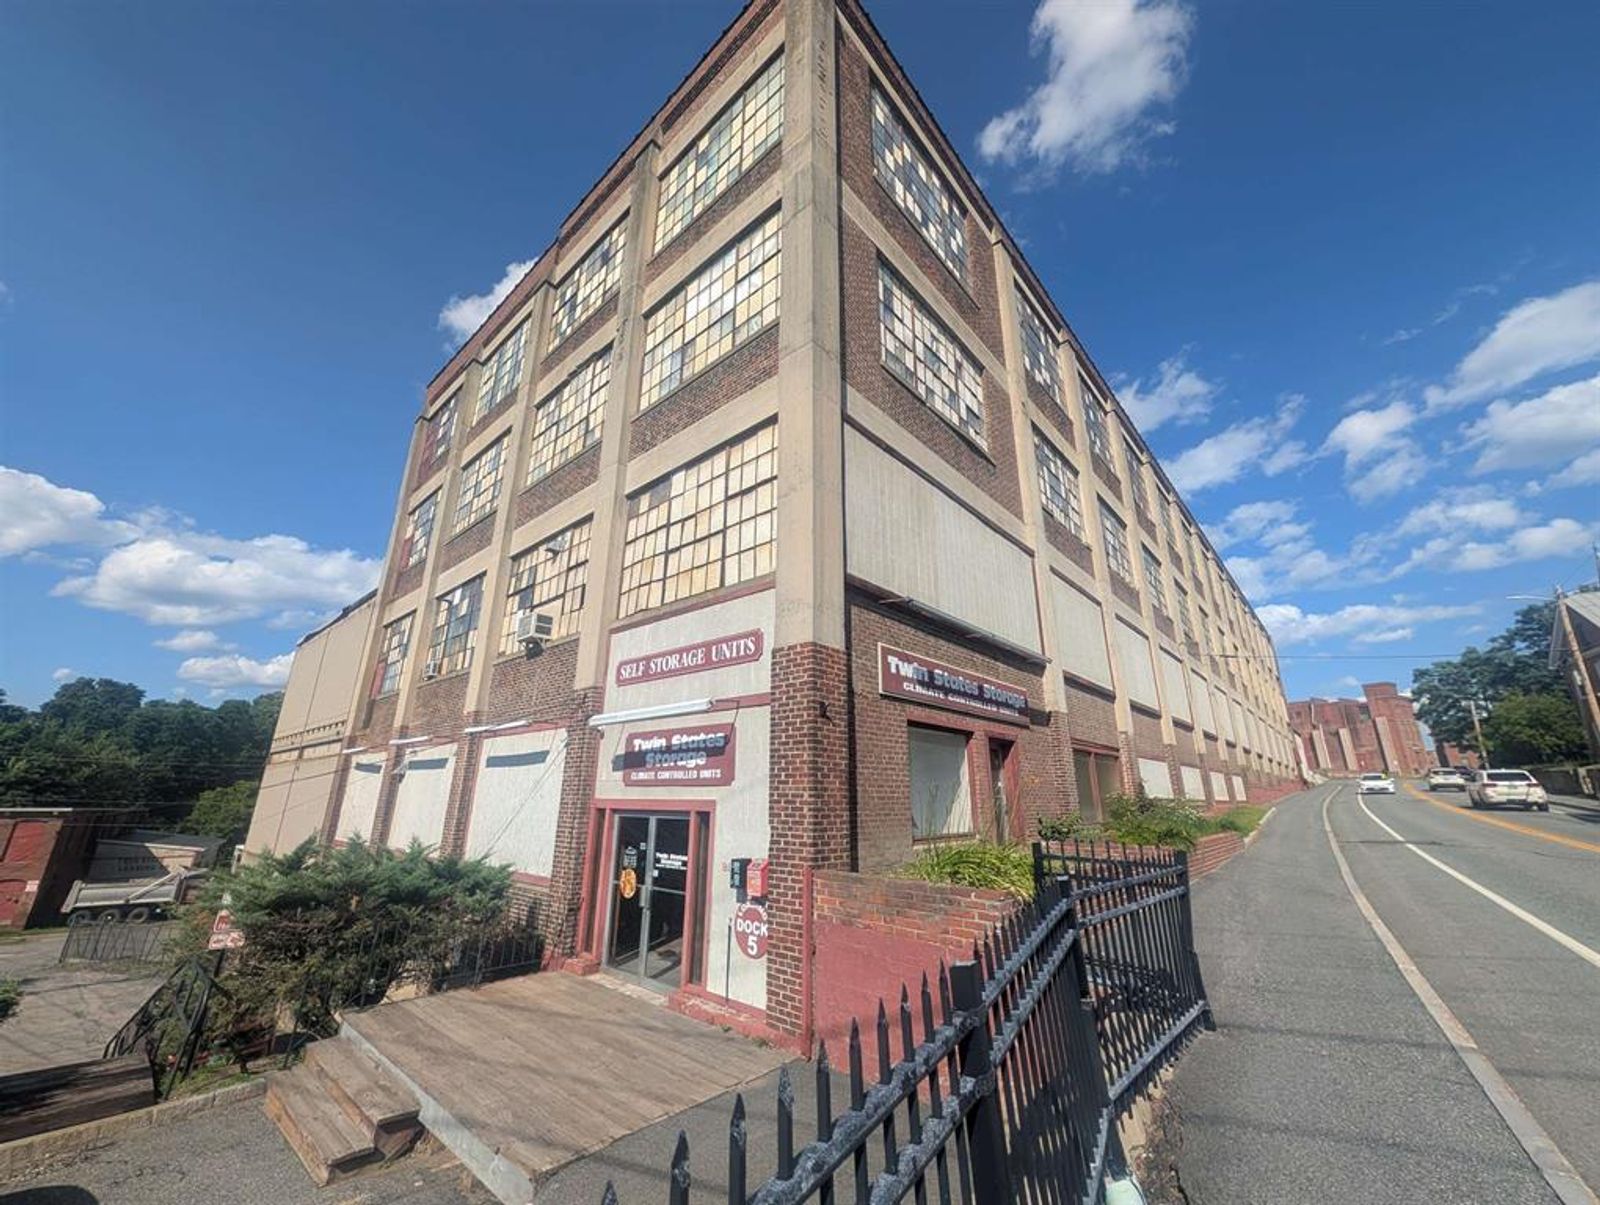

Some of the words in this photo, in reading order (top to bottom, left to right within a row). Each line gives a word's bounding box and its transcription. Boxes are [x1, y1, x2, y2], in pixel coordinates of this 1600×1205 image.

[620, 661, 645, 680] SELF
[650, 648, 705, 674] STORAGE
[712, 637, 756, 661] UNITS
[888, 655, 929, 682] Twin
[934, 670, 979, 695] States
[983, 684, 1026, 708] Storage
[903, 682, 945, 699] CLIMATE
[633, 736, 667, 752] Twin
[672, 732, 725, 750] States
[645, 752, 707, 768] Storage
[631, 771, 655, 780] CLIMATE
[657, 770, 698, 779] CONTROLLED
[737, 918, 768, 936] DOCK
[747, 936, 758, 955] 5
